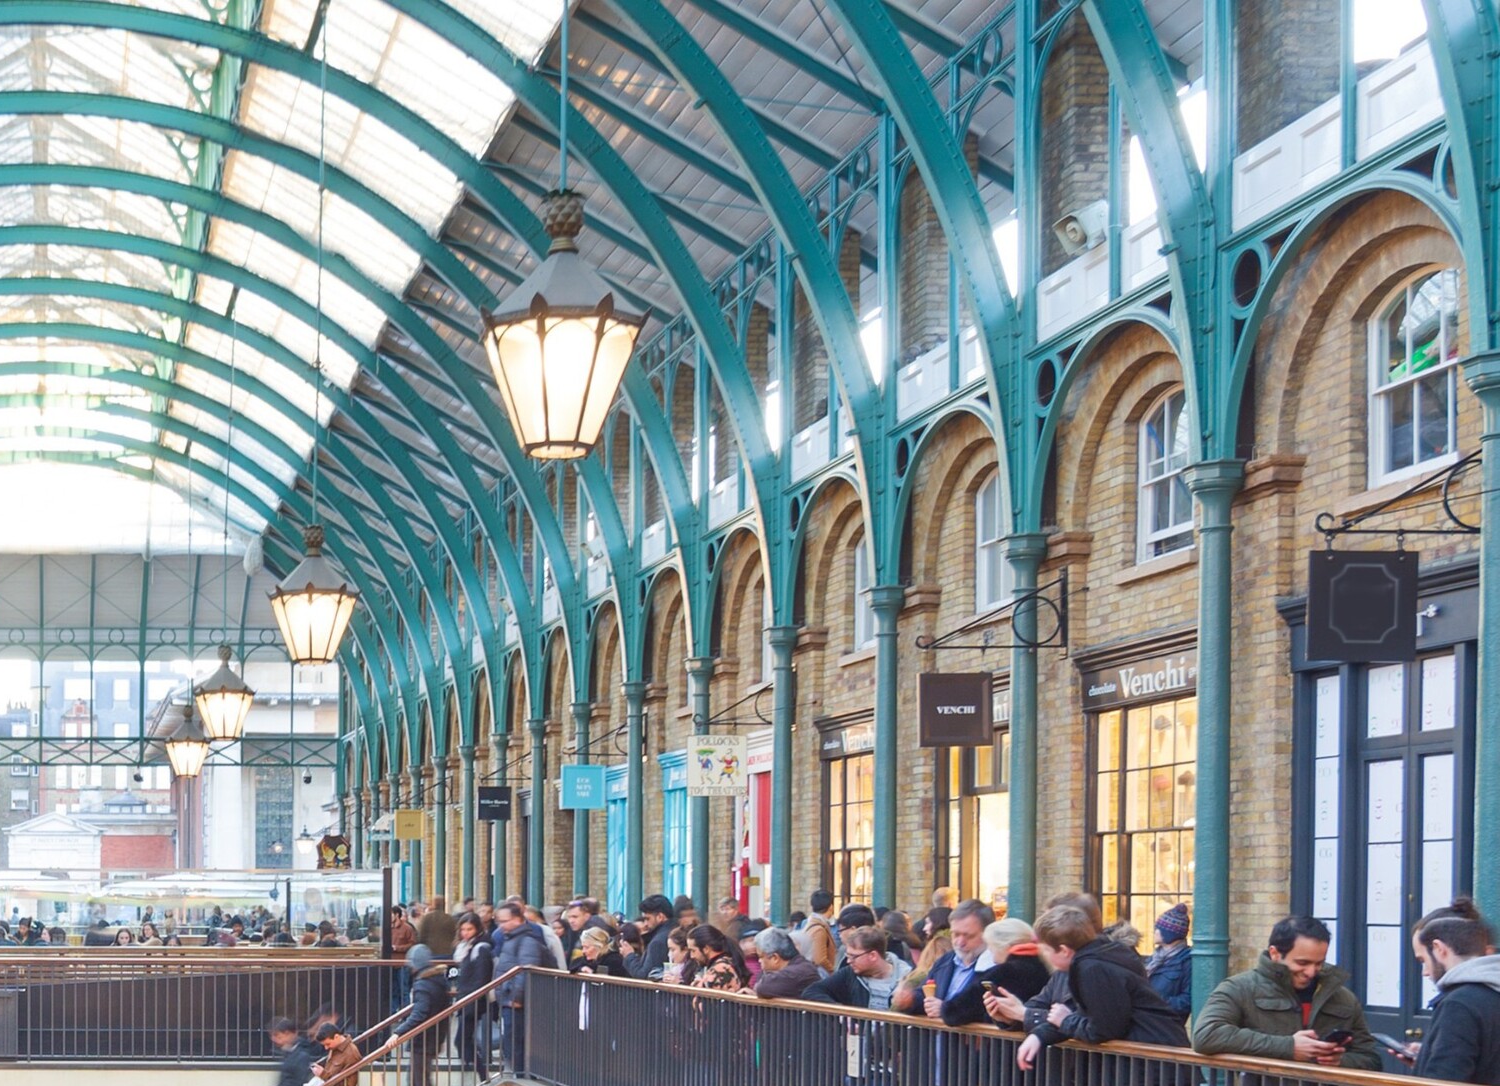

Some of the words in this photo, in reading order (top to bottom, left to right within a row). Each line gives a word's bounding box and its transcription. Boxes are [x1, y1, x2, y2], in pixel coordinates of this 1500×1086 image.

[1119, 656, 1187, 699] Venchi
[936, 704, 976, 715] VENCHI
[841, 725, 875, 753] Vench
